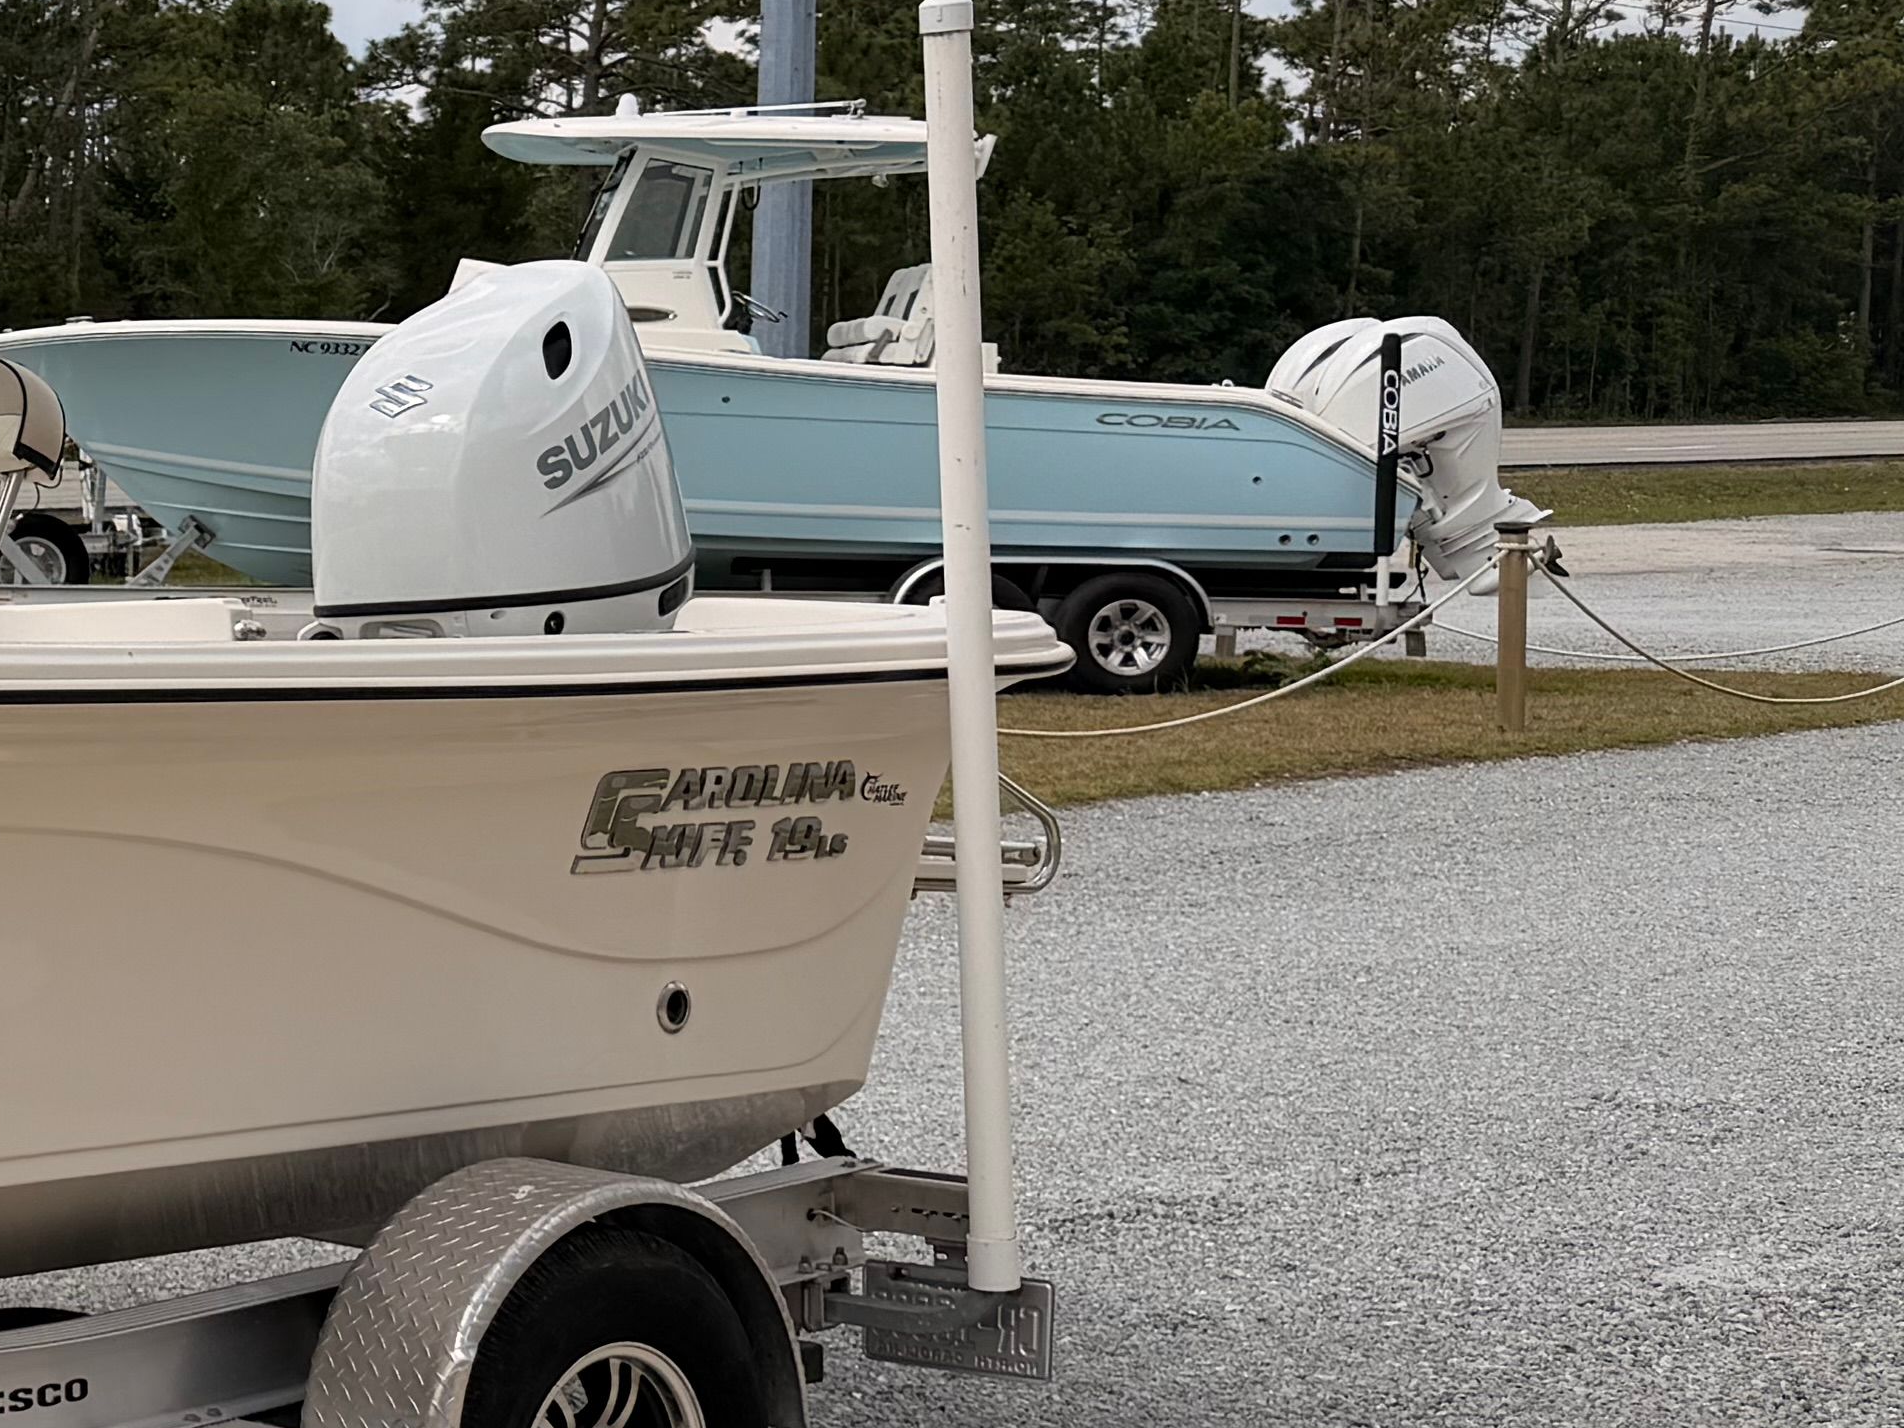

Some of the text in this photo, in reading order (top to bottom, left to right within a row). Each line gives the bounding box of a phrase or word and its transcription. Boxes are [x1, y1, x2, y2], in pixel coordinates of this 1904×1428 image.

[290, 340, 317, 354] NC
[320, 341, 360, 356] 9332
[1401, 356, 1446, 387] AMAHA
[536, 369, 651, 490] SUZUKI
[1095, 412, 1241, 432] COBIA
[1382, 369, 1399, 456] COBIA
[581, 759, 857, 850] CAROLINA
